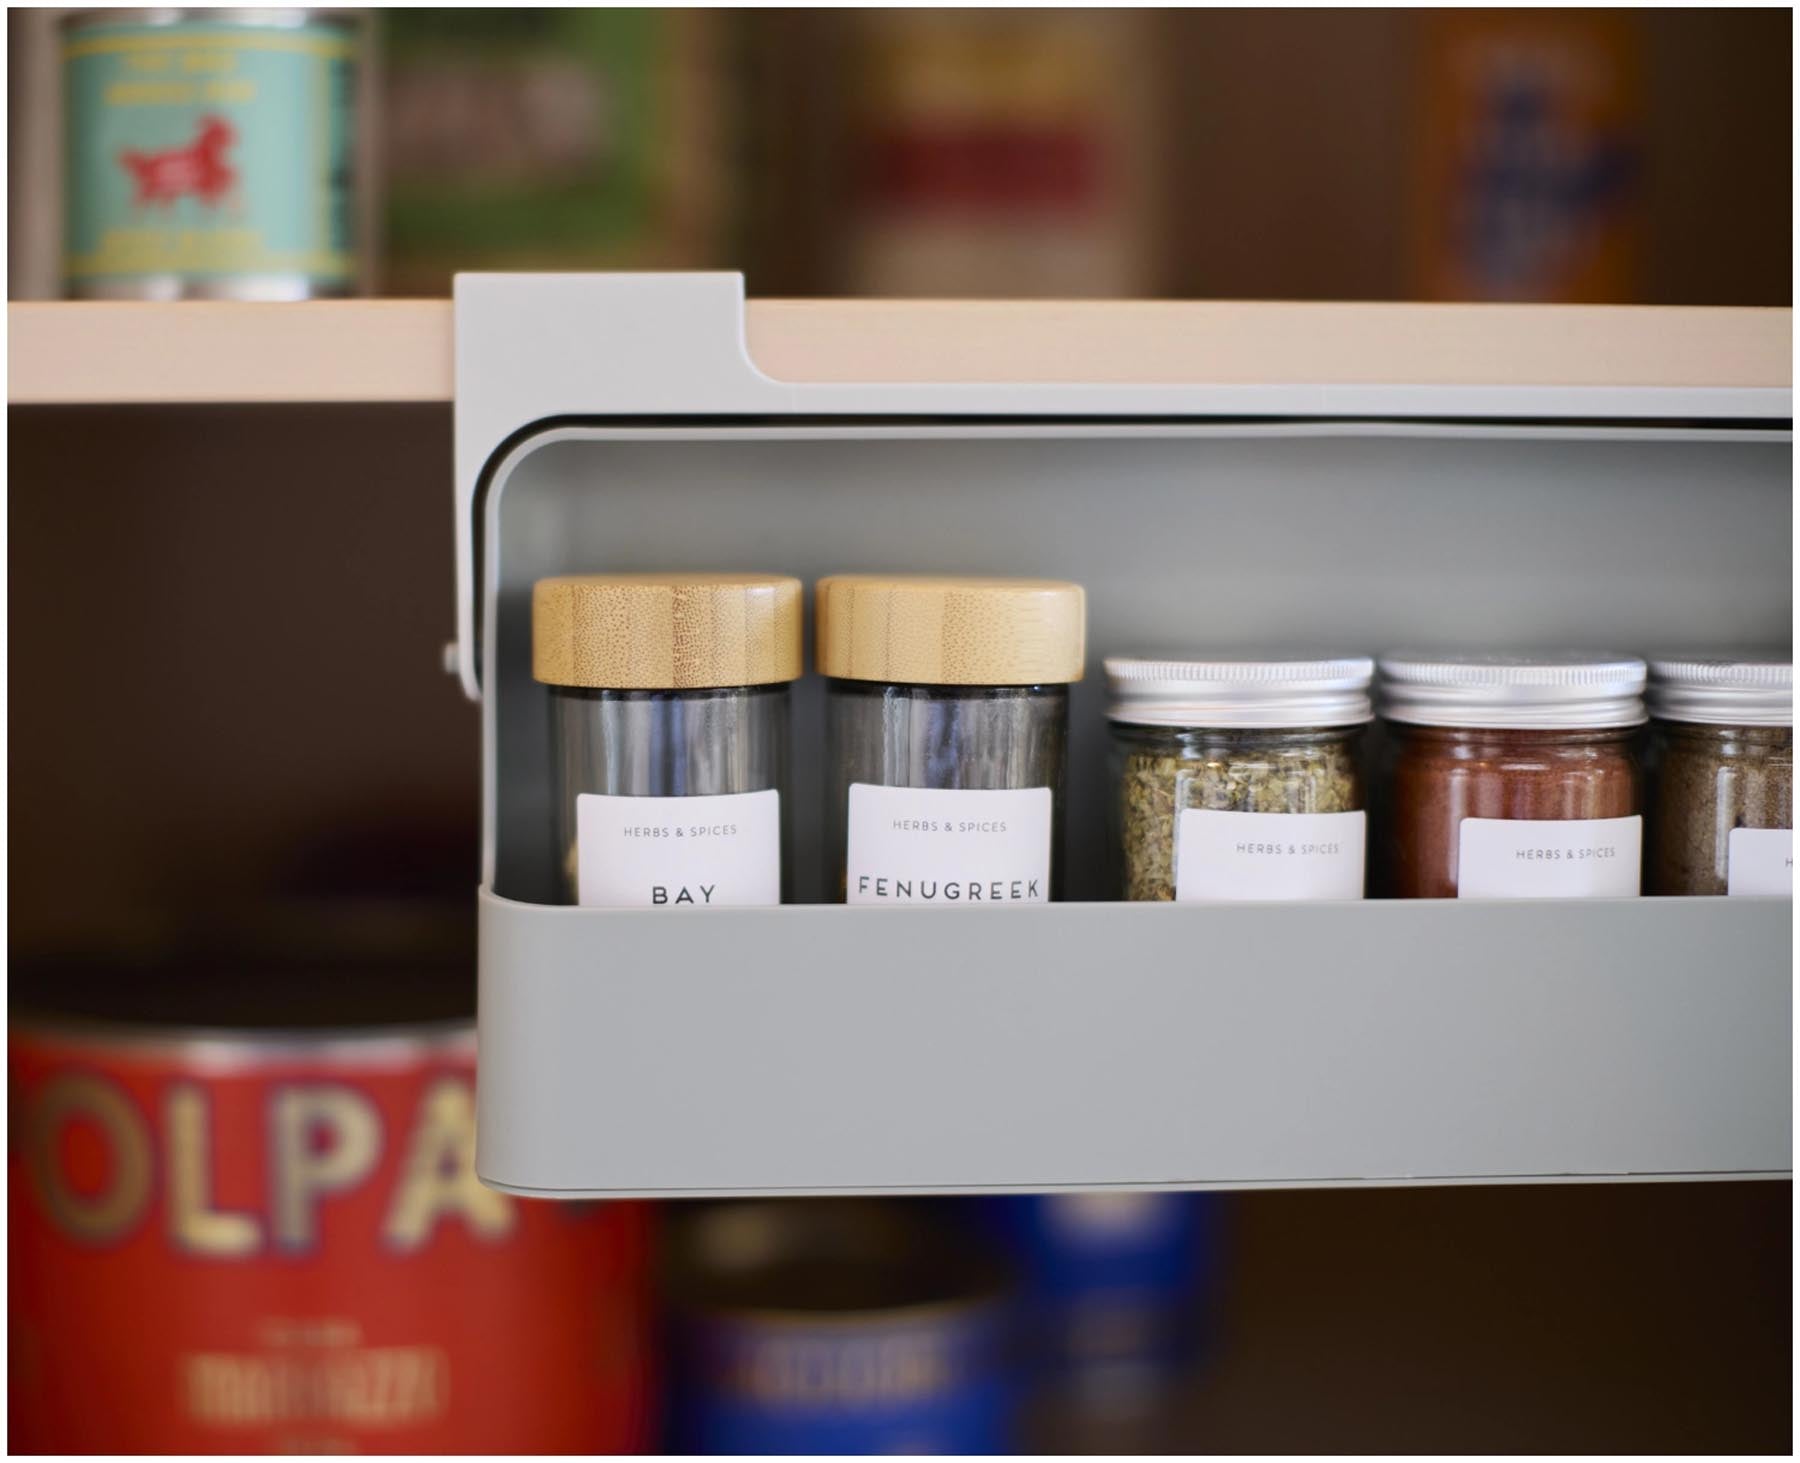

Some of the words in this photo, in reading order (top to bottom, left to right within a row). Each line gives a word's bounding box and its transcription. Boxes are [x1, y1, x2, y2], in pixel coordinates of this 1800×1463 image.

[623, 826, 670, 839] HERBS
[674, 827, 685, 839] &
[689, 823, 738, 837] SPICES
[892, 819, 939, 832] HERBS
[943, 821, 954, 833] &
[958, 820, 1008, 833] SPICES
[1236, 842, 1283, 855] HERBS
[1287, 844, 1296, 855] &
[1300, 842, 1340, 855] SPICES
[1515, 847, 1562, 861] HERBS
[1565, 848, 1575, 861] &
[1577, 846, 1616, 860] SPICES
[652, 884, 716, 905] BAY
[858, 875, 1039, 902] FENUGREEK
[30, 1068, 600, 1257] OLPA
